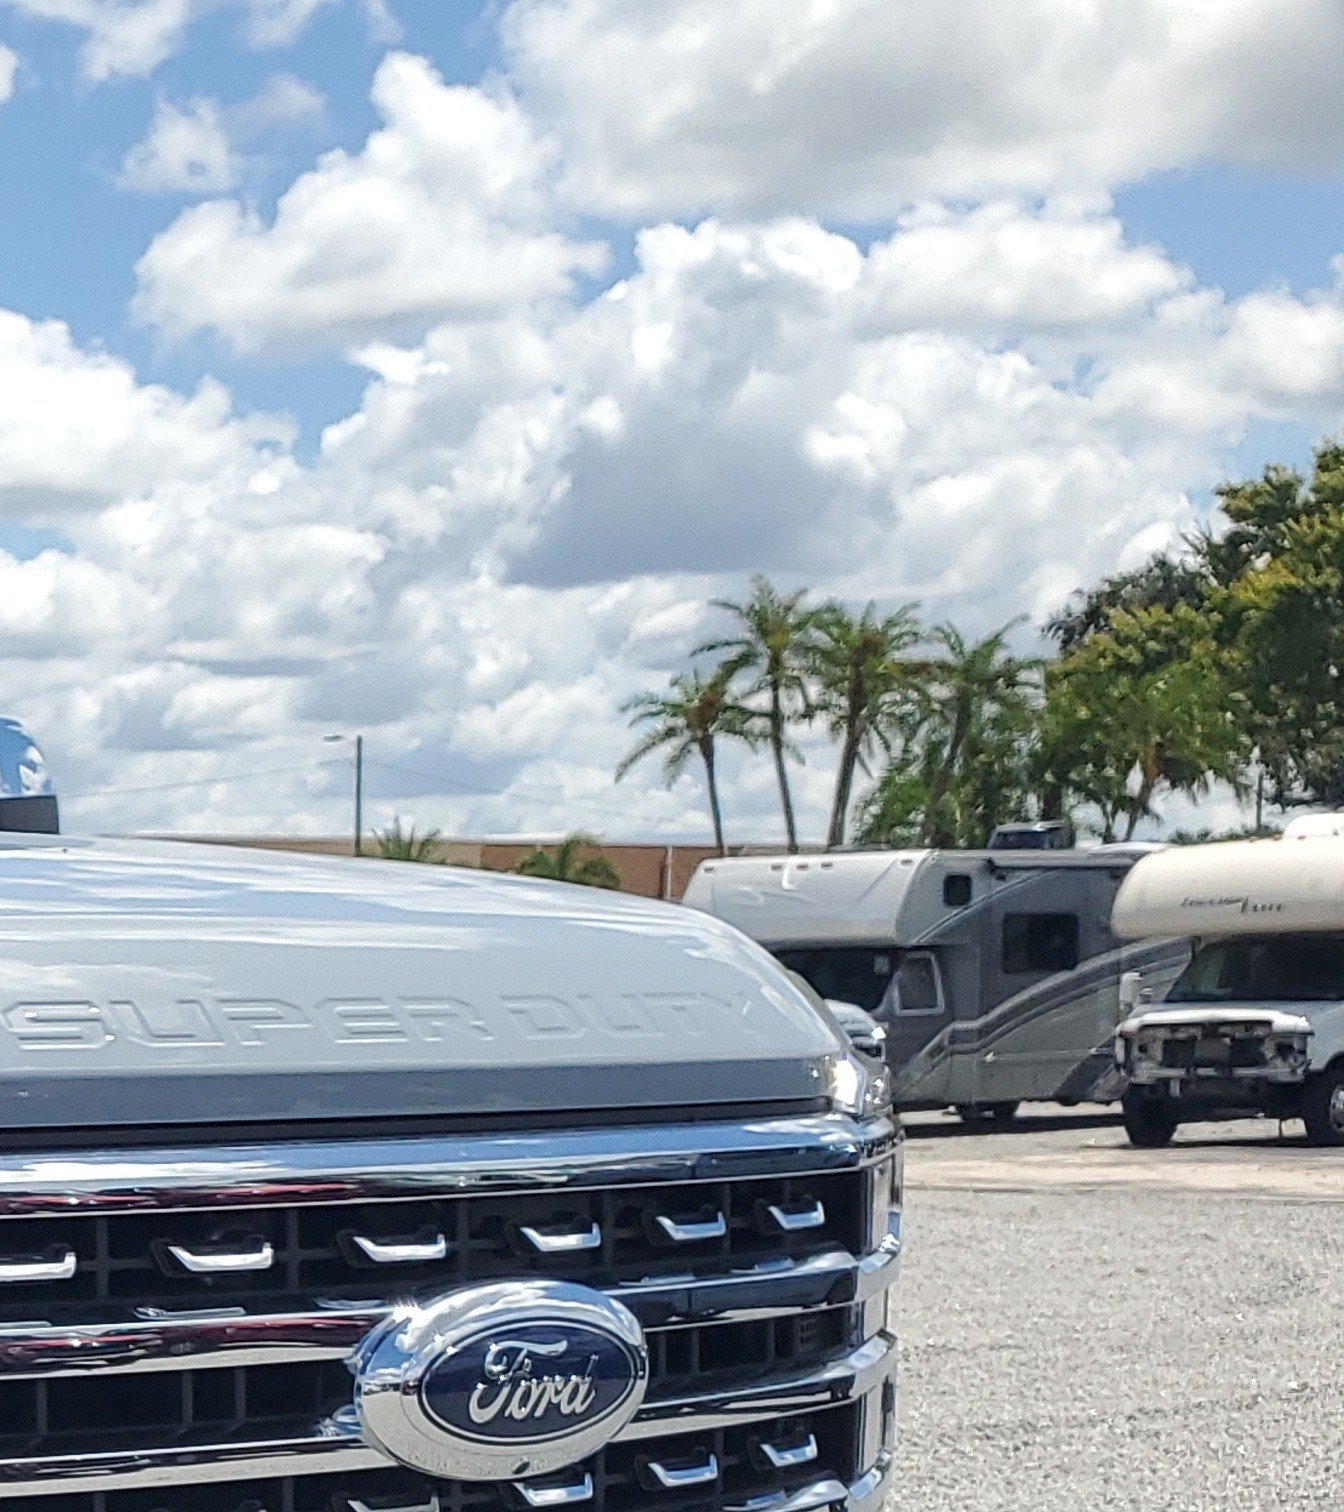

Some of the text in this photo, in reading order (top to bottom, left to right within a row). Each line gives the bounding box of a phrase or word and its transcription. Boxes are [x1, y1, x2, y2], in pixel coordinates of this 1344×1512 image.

[0, 991, 760, 1051] SUPER DUTY
[468, 1339, 600, 1425] Ford
